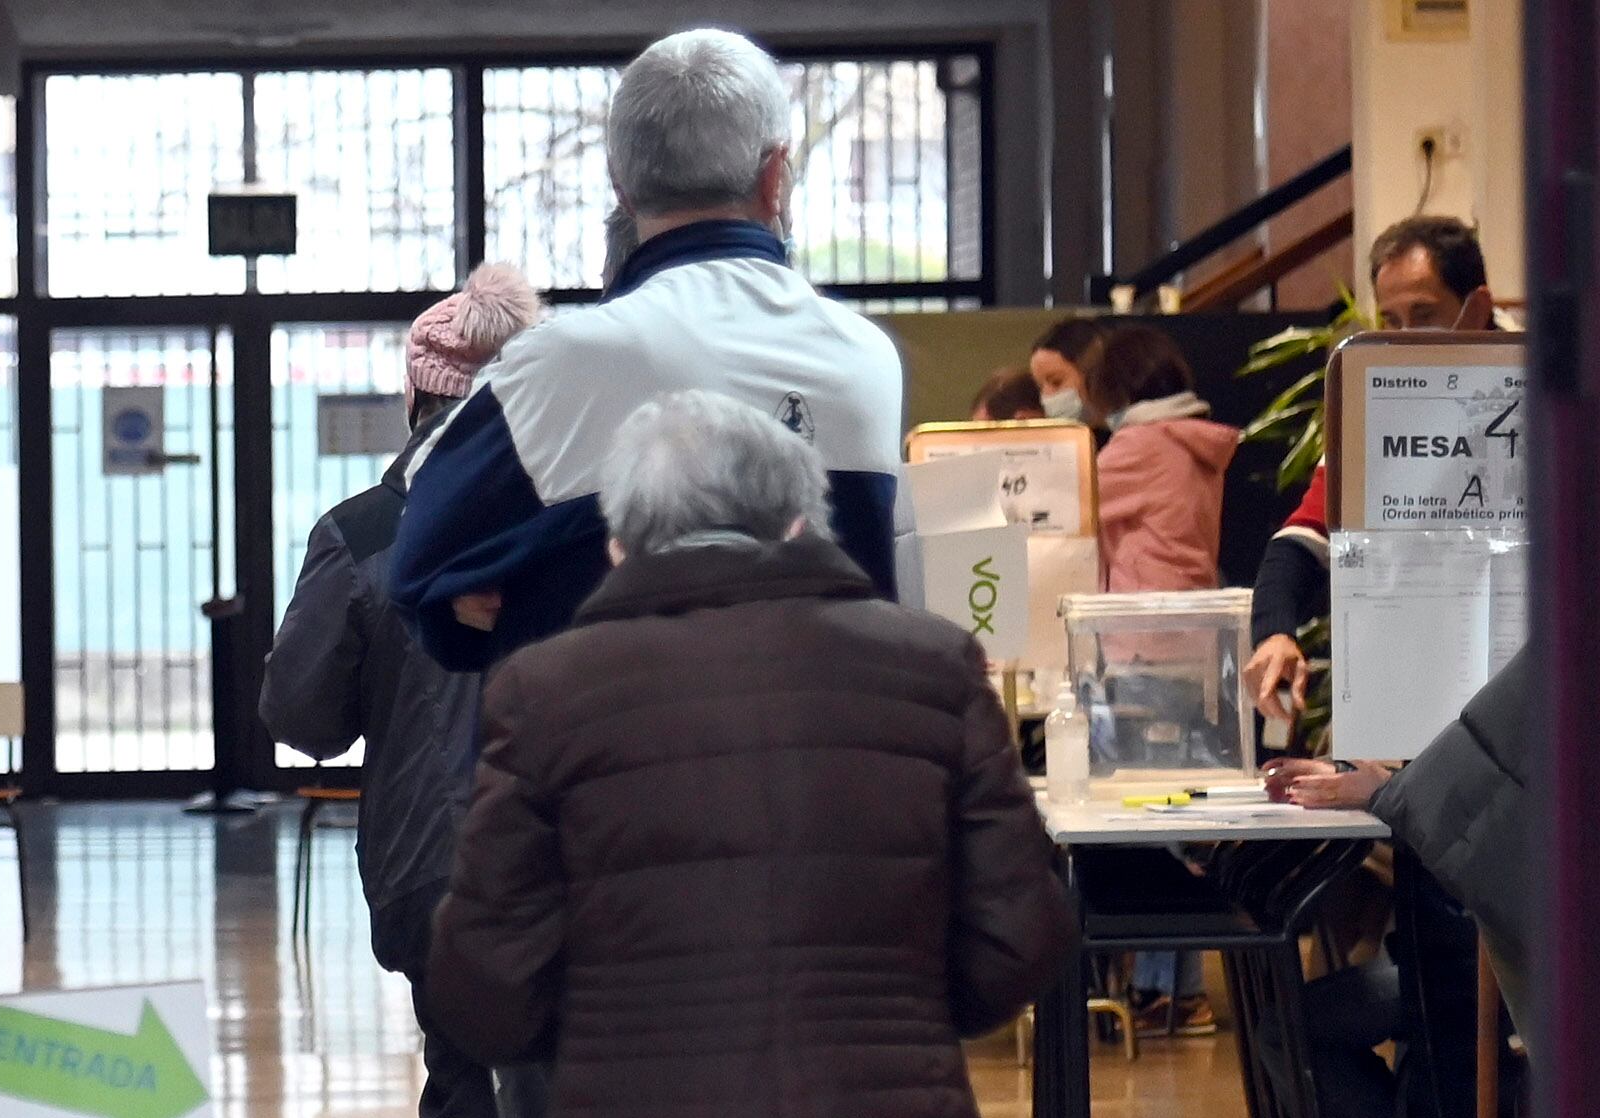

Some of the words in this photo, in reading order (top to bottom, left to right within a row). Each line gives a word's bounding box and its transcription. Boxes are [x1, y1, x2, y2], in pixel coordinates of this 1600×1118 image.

[1372, 376, 1428, 389] Distrito
[1446, 374, 1458, 390] 8
[1382, 435, 1473, 458] MESA
[1484, 400, 1520, 459] 4
[1382, 495, 1399, 506] De
[1403, 495, 1416, 506] la
[1418, 495, 1447, 506] letra
[1457, 475, 1485, 508] A
[1516, 498, 1524, 506] a
[1382, 508, 1427, 521] (Orden
[1430, 507, 1495, 521] alfabético
[968, 556, 1001, 635] VOX
